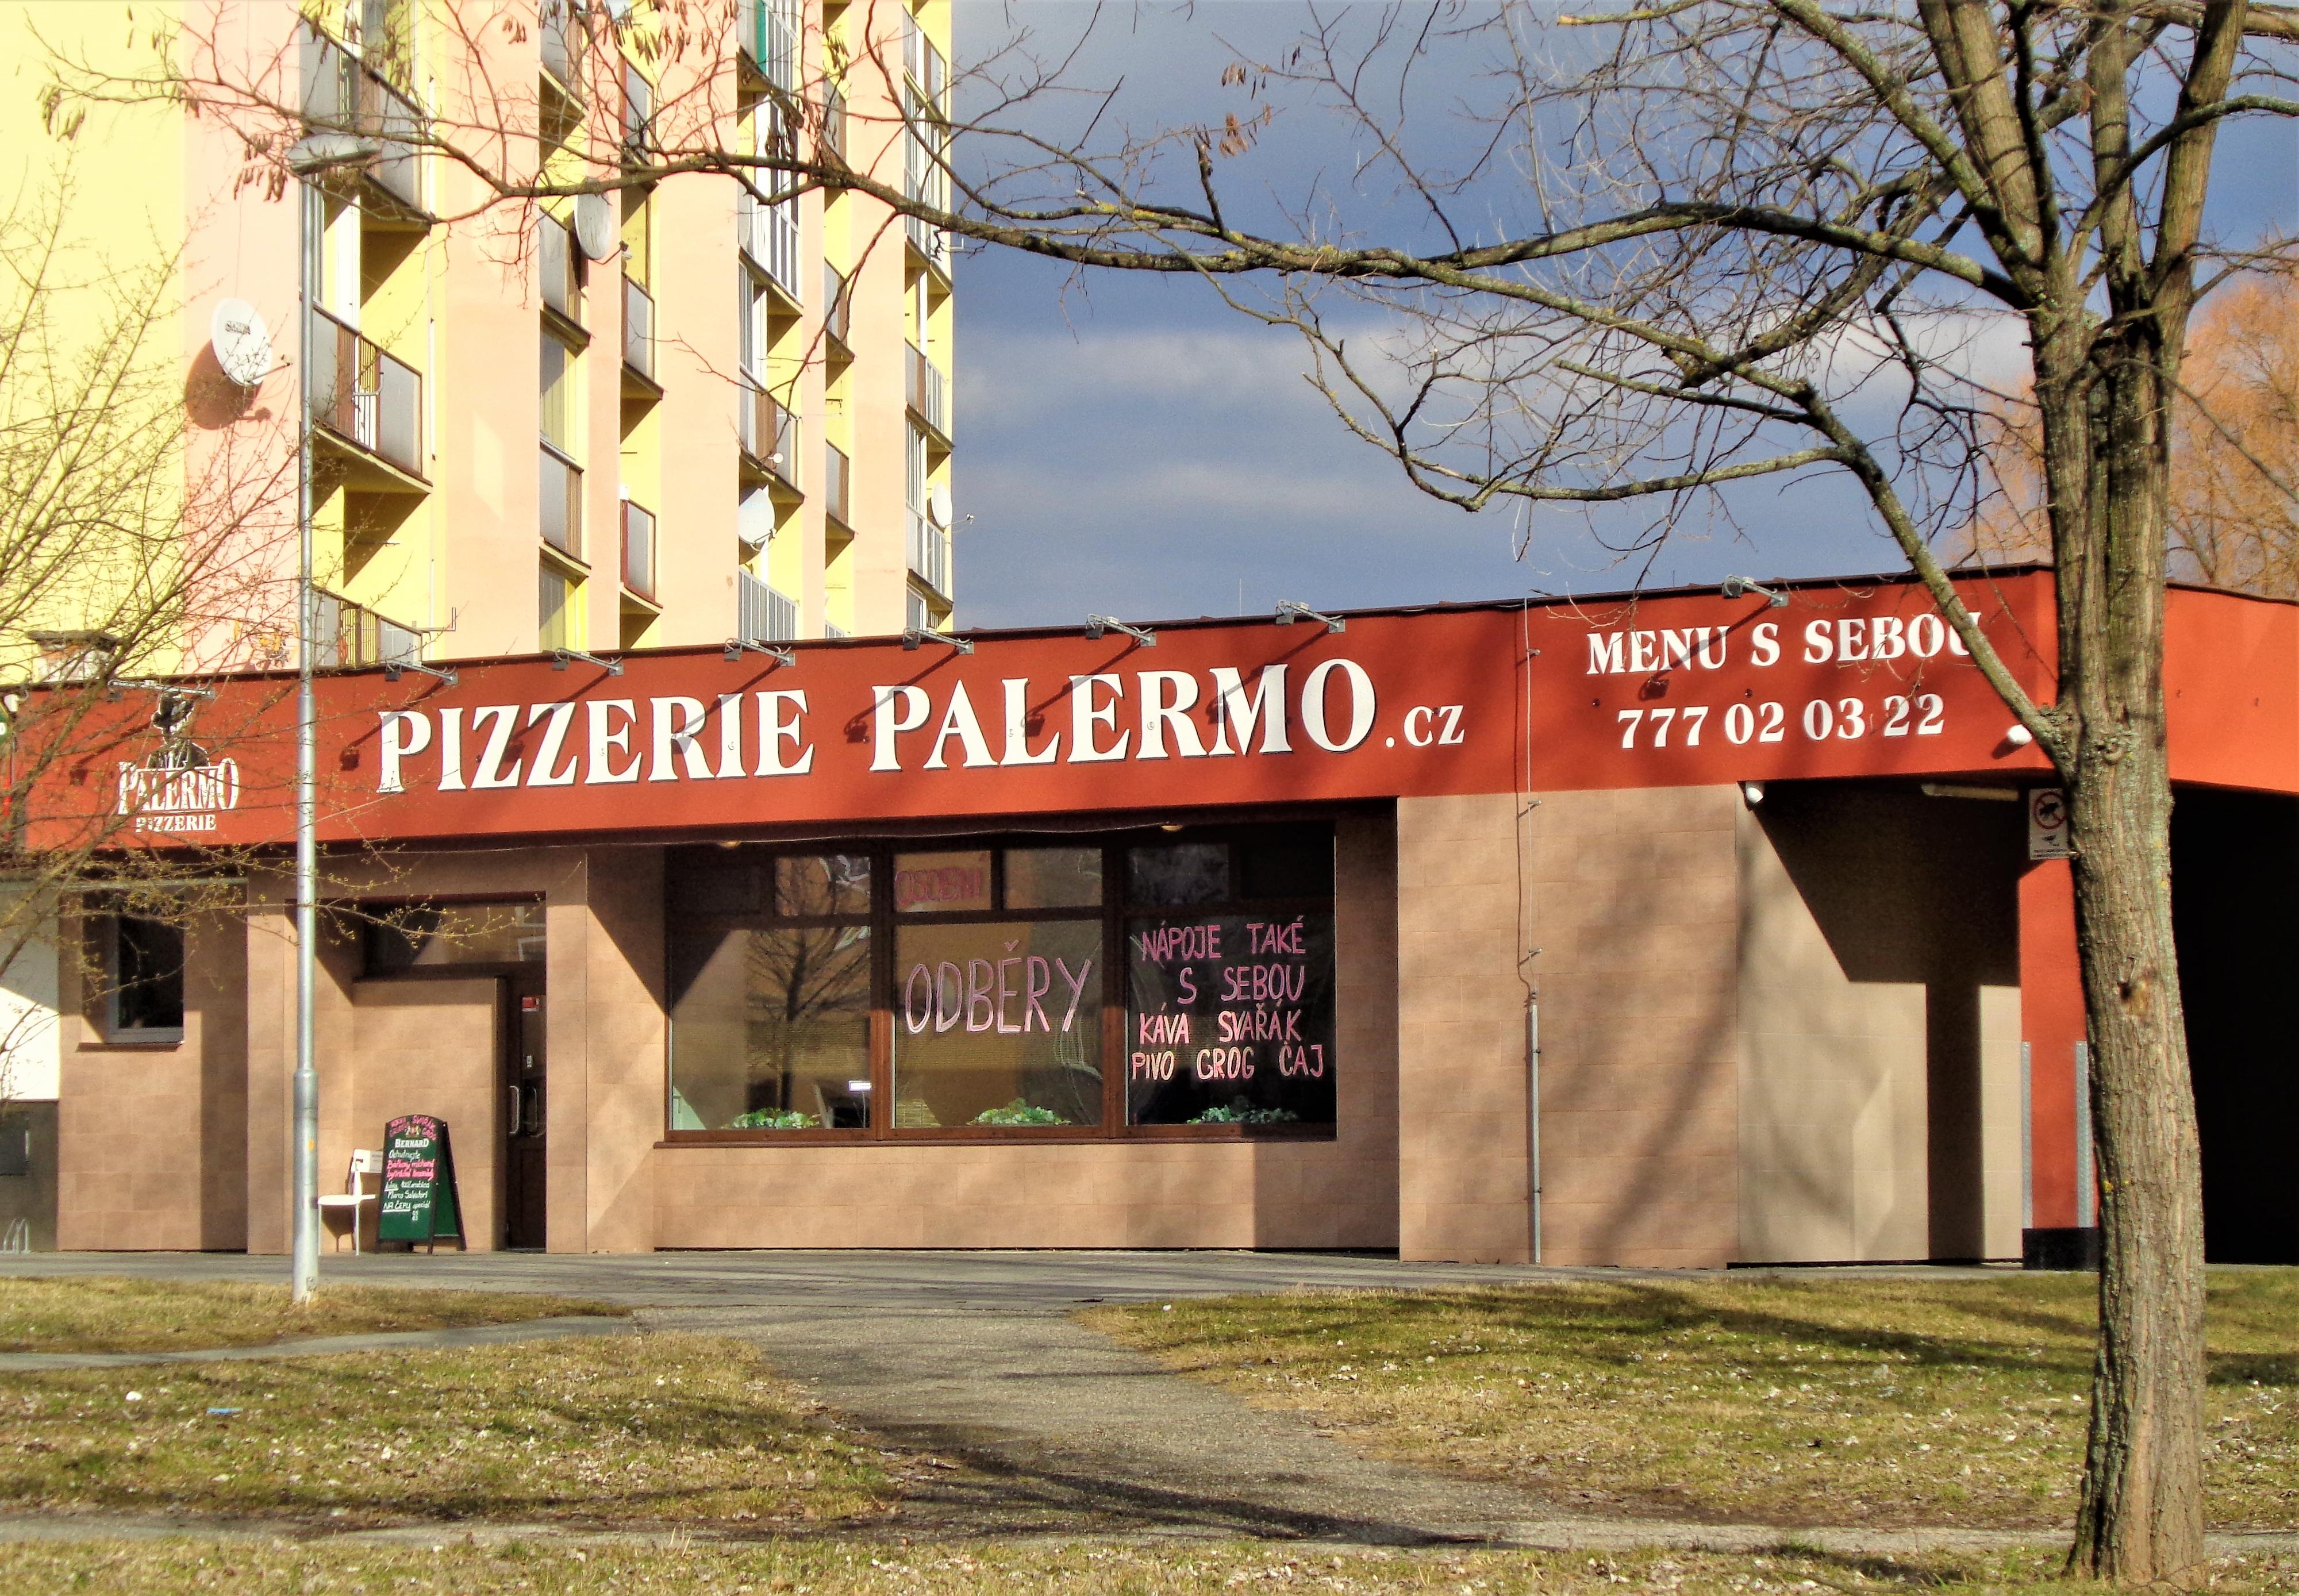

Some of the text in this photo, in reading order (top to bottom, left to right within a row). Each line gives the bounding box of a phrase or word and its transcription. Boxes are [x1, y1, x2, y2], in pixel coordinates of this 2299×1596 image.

[1586, 625, 1730, 675] MENU
[1750, 622, 1781, 668] S
[376, 689, 814, 794] PIZZERIE
[1617, 693, 1945, 749] 777 02 03 22
[118, 757, 240, 814] PALERMO
[135, 814, 217, 833] PIZZERIE
[1142, 915, 1306, 962] NÁPOJE TAKÉ
[905, 939, 1092, 1034] ODBĚRY
[1177, 963, 1305, 1005] S SEBOU
[1139, 998, 1302, 1044] KÁVA SVAŘÁK
[1132, 1040, 1323, 1081] PIVO GROG ČAJ
[394, 1138, 430, 1148] BERNARD
[383, 1202, 394, 1210] NA
[394, 1200, 412, 1210] ČEPU
